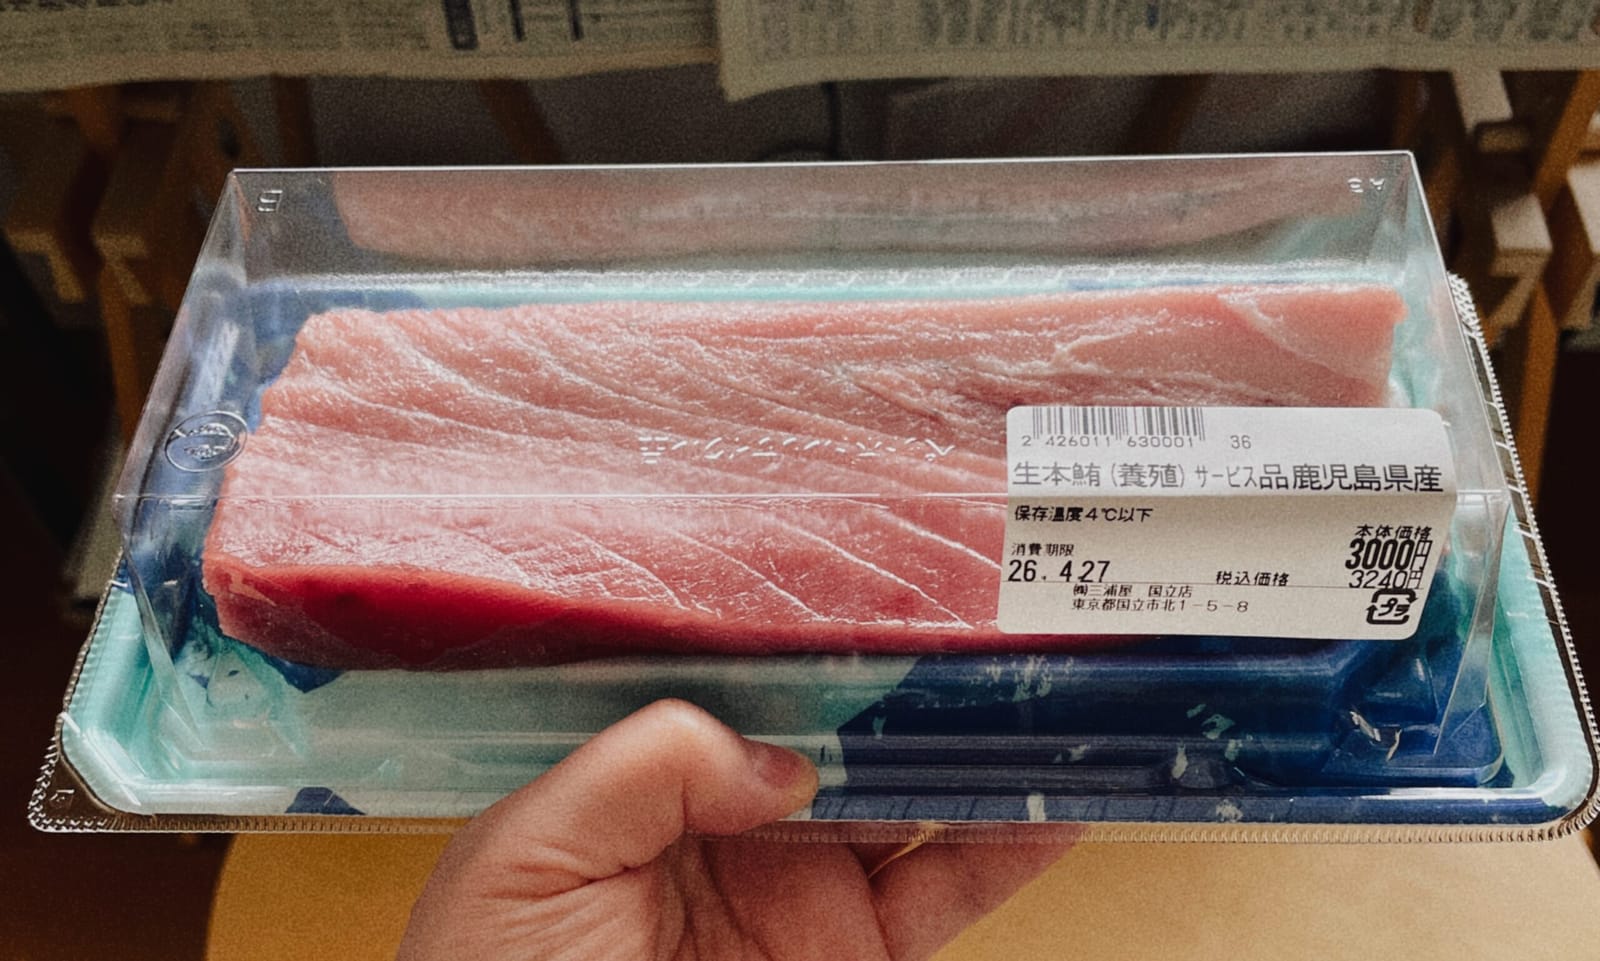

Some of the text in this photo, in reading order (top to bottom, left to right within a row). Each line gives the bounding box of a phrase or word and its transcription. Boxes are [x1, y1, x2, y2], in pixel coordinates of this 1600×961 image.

[1021, 435, 1252, 449] 2 426011 630001 36
[1354, 524, 1433, 541] 本体価格
[1011, 543, 1075, 556] 消費期限
[1344, 539, 1433, 570] 3000円
[1215, 570, 1424, 589] 税込価格 3240円
[1148, 585, 1193, 598] 国立店
[1377, 598, 1411, 618] プラ
